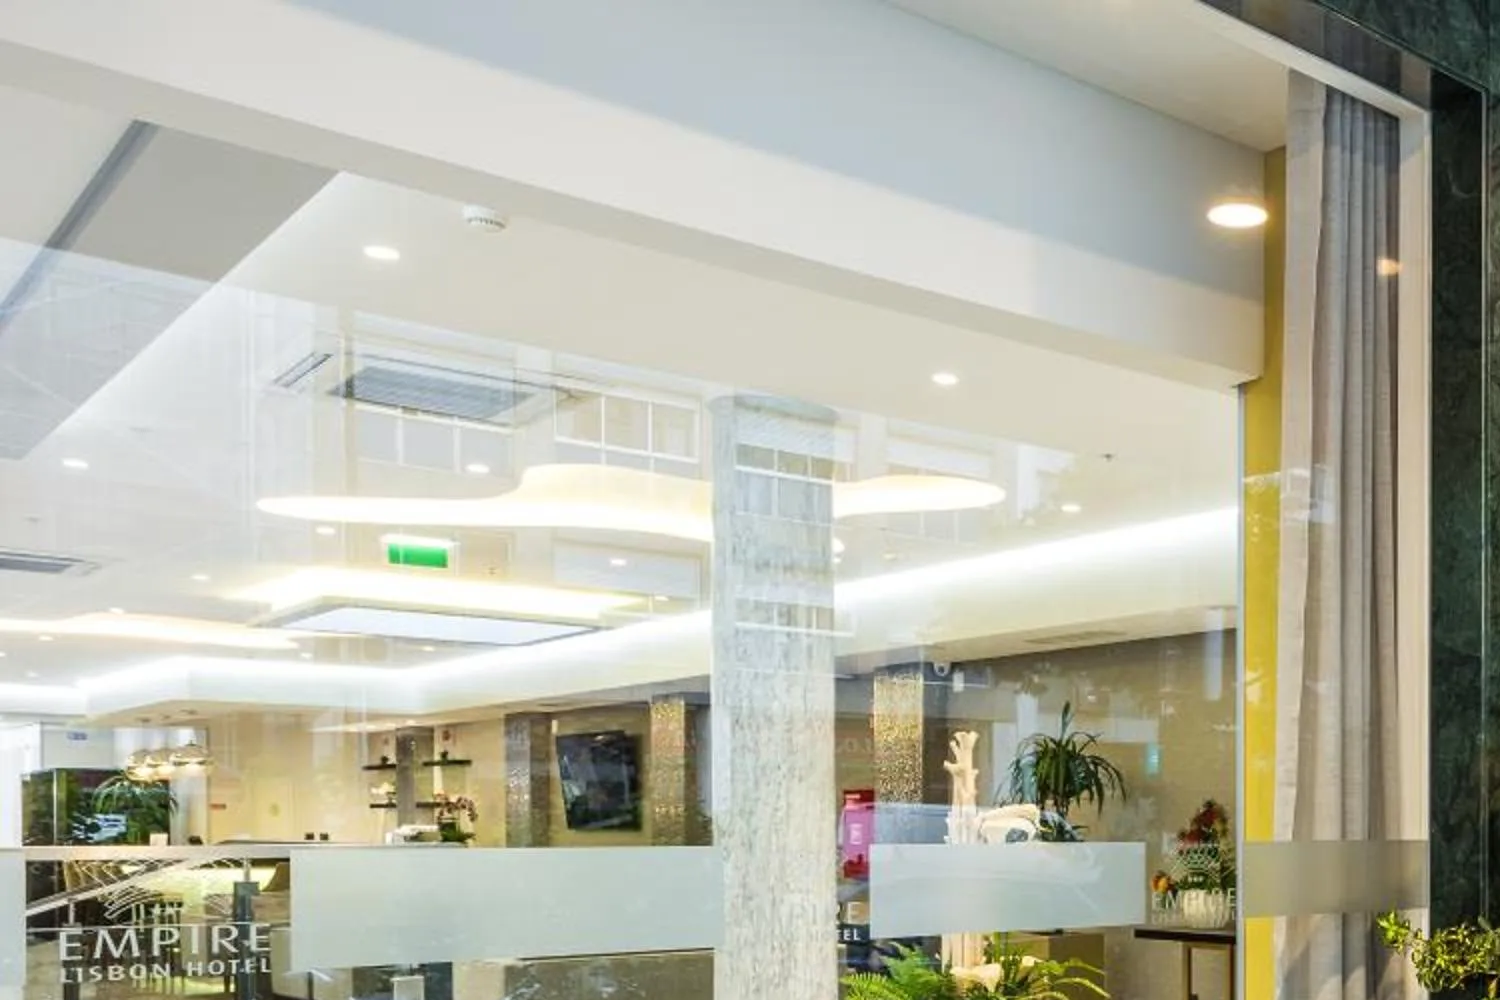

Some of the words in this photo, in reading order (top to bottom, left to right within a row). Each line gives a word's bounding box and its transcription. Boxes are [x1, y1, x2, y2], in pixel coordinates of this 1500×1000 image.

[59, 923, 271, 960] EMPIRE
[60, 963, 171, 983] LISBON
[187, 958, 271, 977] HOTEL
